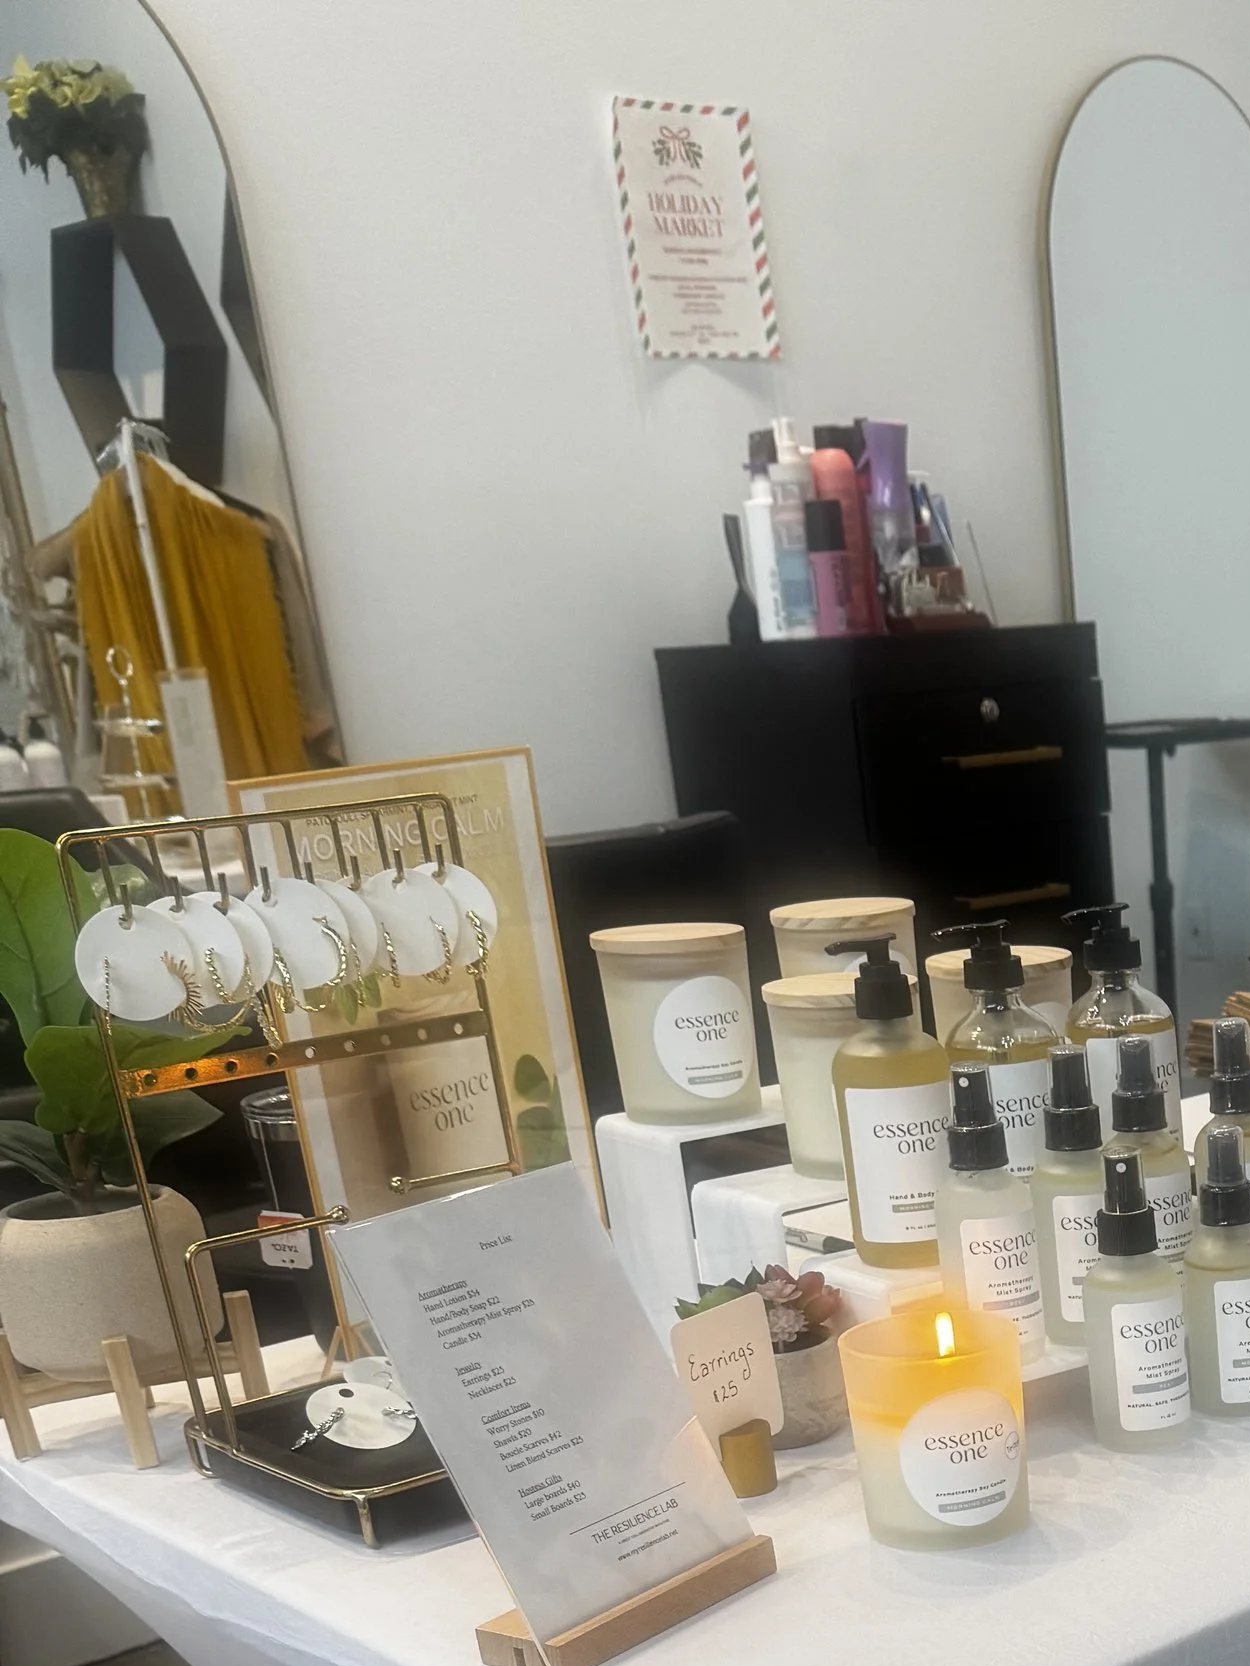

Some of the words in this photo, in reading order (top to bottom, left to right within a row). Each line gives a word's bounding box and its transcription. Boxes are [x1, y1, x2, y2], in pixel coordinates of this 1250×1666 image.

[648, 192, 724, 216] HOLIDAY
[653, 215, 725, 238] MARKET
[297, 820, 422, 865] MORNNG
[675, 1010, 740, 1030] essence
[696, 1026, 728, 1042] one
[410, 1071, 489, 1112] essence
[434, 1103, 474, 1131] one
[873, 1116, 949, 1139] essence
[998, 1112, 1036, 1130] one
[898, 1136, 936, 1155] one
[917, 1191, 935, 1199] Body
[1163, 1206, 1191, 1226] one
[478, 1240, 498, 1251] Price
[497, 1234, 513, 1245] List
[994, 1250, 1029, 1271] one
[418, 1280, 468, 1301] Aromatherapy
[988, 1275, 1034, 1289] Aromatherapy
[996, 1288, 1012, 1296] Mist
[1014, 1284, 1032, 1294] Spray
[423, 1300, 444, 1313] Hand
[443, 1293, 467, 1307] Lotion
[429, 1307, 470, 1326] Hand/Body
[469, 1301, 487, 1312] Soap
[437, 1316, 487, 1338] Aromatherapy
[485, 1309, 503, 1321] Mist
[502, 1303, 522, 1317] Spray
[443, 1337, 468, 1350] Candle
[1145, 1333, 1178, 1354] one
[455, 1361, 482, 1376] Jewelry
[688, 1342, 754, 1381] Earrings
[1138, 1358, 1182, 1372] Aromatherapy
[461, 1372, 492, 1388] Earrings
[491, 1365, 505, 1377] $25
[1146, 1371, 1162, 1379] Mist
[1164, 1367, 1180, 1377] Spray
[481, 1407, 511, 1425] Comfort
[510, 1401, 531, 1415] Items
[486, 1422, 510, 1437] Worry
[509, 1414, 533, 1428] Stones
[533, 1408, 545, 1419] $10
[493, 1434, 519, 1449] Shawls
[518, 1428, 532, 1439] $20
[924, 1423, 1004, 1451] essence
[499, 1446, 523, 1461] Boucle
[523, 1437, 550, 1452] Scarves
[505, 1460, 527, 1473] Linen
[526, 1451, 547, 1465] Blend
[545, 1442, 571, 1456] Scarves
[950, 1444, 988, 1465] one
[518, 1480, 546, 1499] Hostess
[545, 1474, 563, 1488] Gifts
[524, 1496, 546, 1510] Large
[544, 1487, 568, 1502] boards
[566, 1480, 581, 1491] $40
[935, 1488, 978, 1498] Aromatherapy
[531, 1508, 551, 1521] Small
[550, 1498, 574, 1514] Boards
[591, 1528, 612, 1545] THE
[611, 1505, 663, 1536] RESILIENCE
[661, 1498, 679, 1514] LAB
